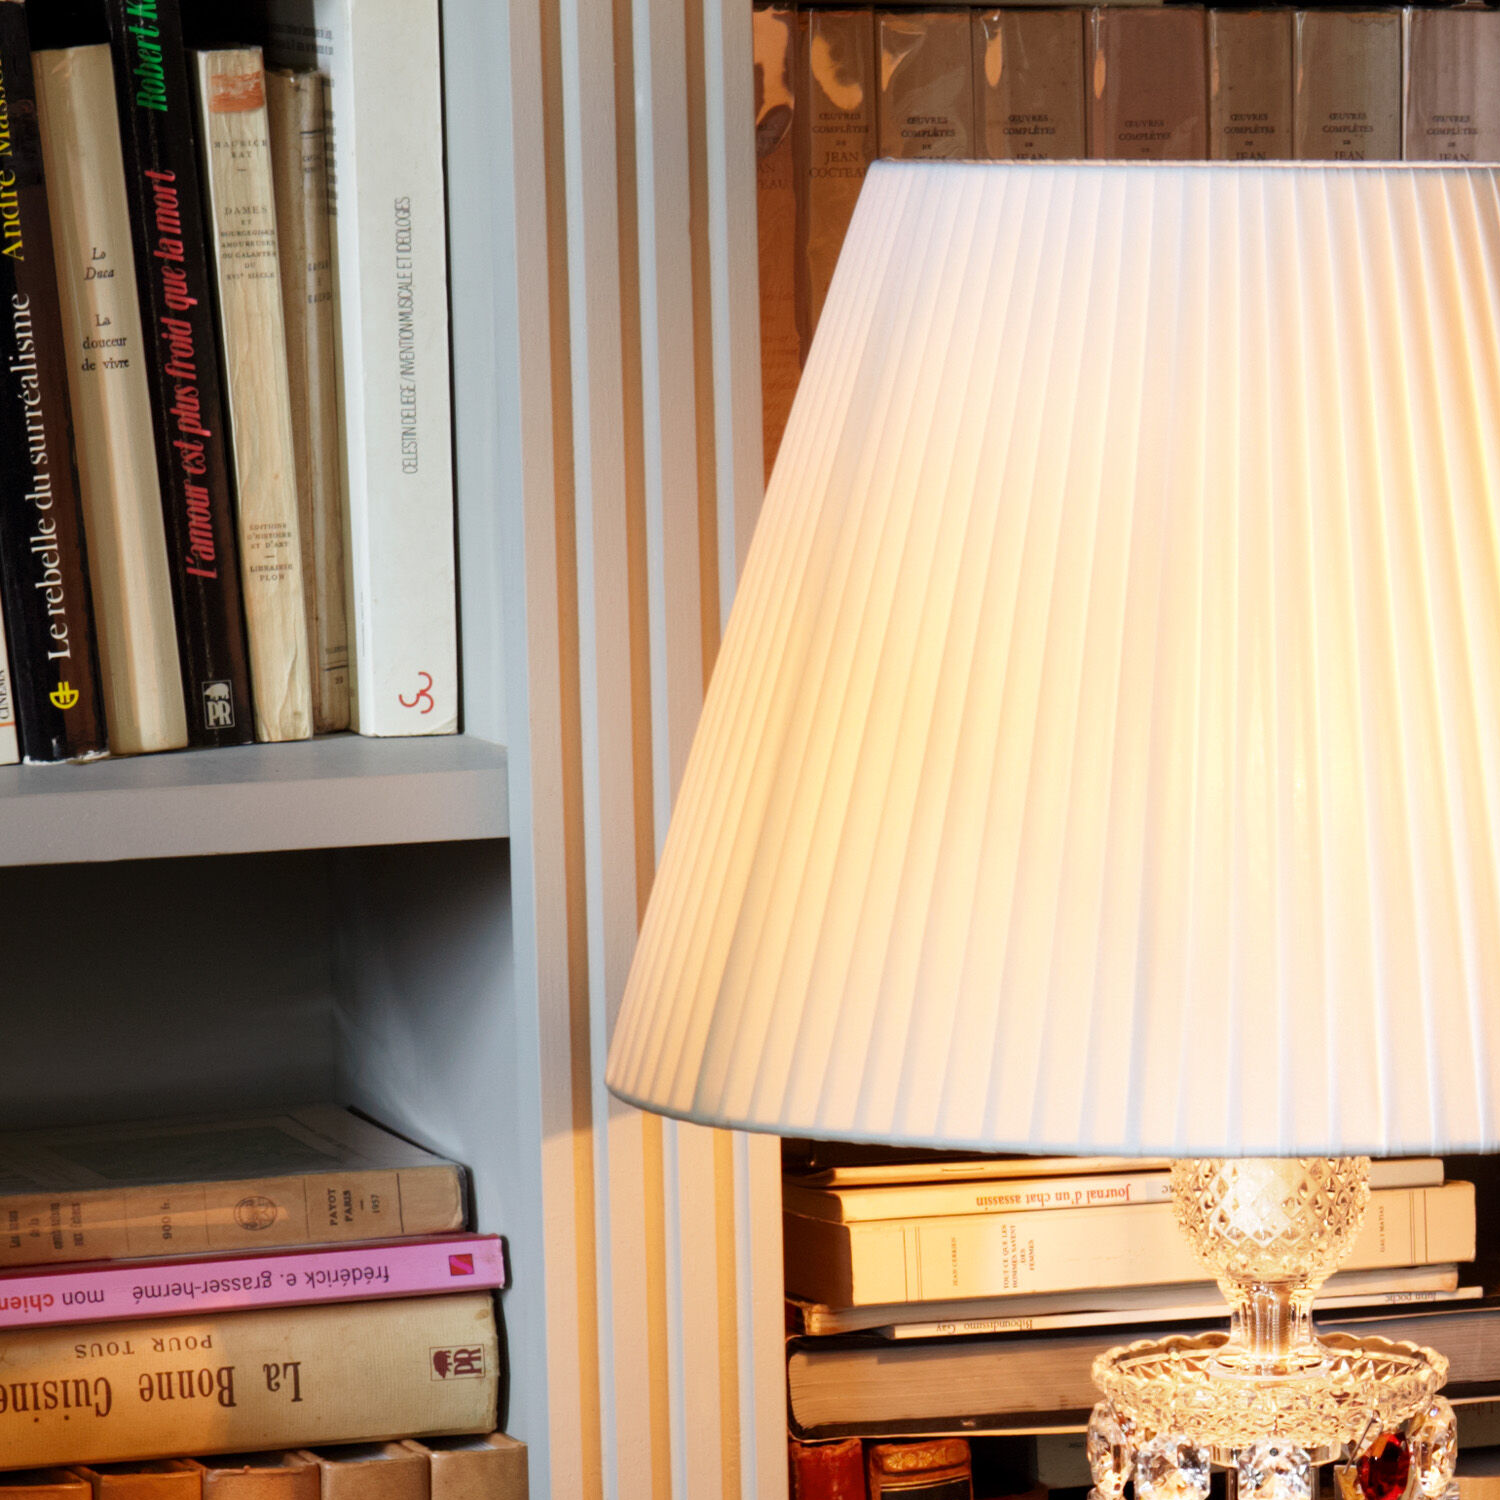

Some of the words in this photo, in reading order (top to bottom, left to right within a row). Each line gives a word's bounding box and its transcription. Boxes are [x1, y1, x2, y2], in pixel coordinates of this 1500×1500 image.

[126, 0, 157, 20] K
[128, 25, 168, 112] Robert
[824, 151, 859, 164] JEAN
[144, 169, 182, 236] mort
[224, 205, 268, 215] DAMES
[153, 239, 185, 262] la
[84, 266, 115, 281] Duca
[396, 255, 413, 271] ET
[164, 260, 198, 310] que
[96, 313, 112, 328] La
[82, 335, 128, 350] douceur
[160, 317, 198, 383] froid
[81, 358, 96, 372] de
[102, 357, 130, 370] vivre
[9, 294, 49, 465] surréalisme
[170, 385, 212, 437] plus
[173, 440, 207, 475] est
[25, 473, 53, 513] du
[30, 518, 68, 617] rebelle
[47, 621, 72, 660] Le
[975, 1194, 1021, 1212] assassin
[1024, 1191, 1046, 1207] chat
[1049, 1188, 1082, 1206] d'un
[1091, 1182, 1132, 1202] Journal
[327, 1187, 338, 1227] PAYOT
[343, 1189, 354, 1223] PARIS
[161, 1213, 173, 1240] 900
[131, 1270, 272, 1306] grasser-hermé
[279, 1271, 297, 1287] e.
[304, 1264, 390, 1290] frédérick
[62, 1288, 105, 1305] mon
[74, 1338, 135, 1360] TOUS
[153, 1333, 214, 1354] POUR
[139, 1365, 238, 1407] Bonne
[263, 1361, 303, 1402] La
